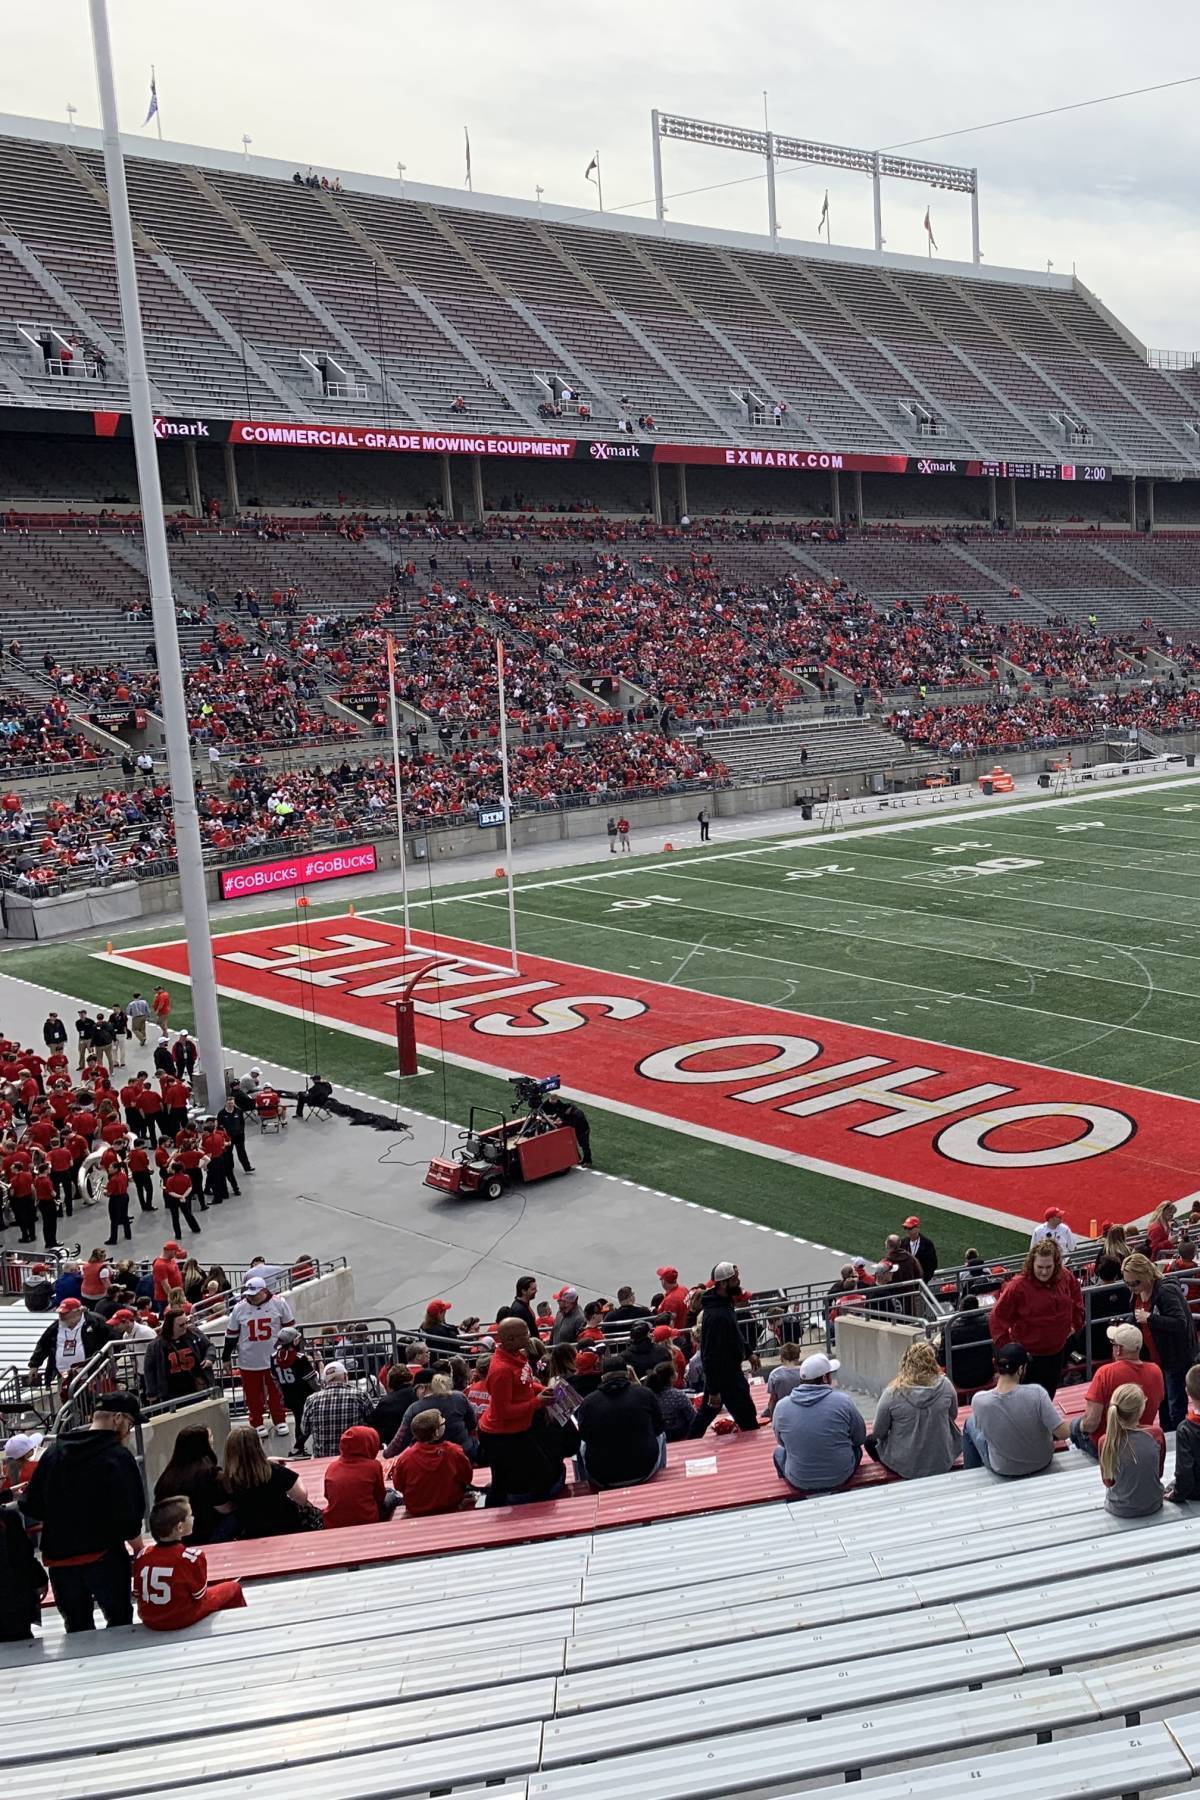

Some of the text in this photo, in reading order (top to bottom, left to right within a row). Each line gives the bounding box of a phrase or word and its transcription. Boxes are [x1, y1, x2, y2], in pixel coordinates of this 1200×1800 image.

[153, 416, 210, 440] Xmark
[241, 426, 571, 457] COMMERCIAL-GRADE MOWING EQUIPMENT
[725, 450, 844, 469] EXMARK.COM
[1084, 466, 1106, 480] 2:00
[349, 696, 378, 704] CAMBRIA
[96, 712, 130, 721] TANSKY
[481, 811, 505, 824] BTN
[214, 932, 1137, 1168] OHIO STATE
[247, 1317, 273, 1342] 15
[168, 1347, 195, 1374] 15
[140, 1565, 174, 1605] 15
